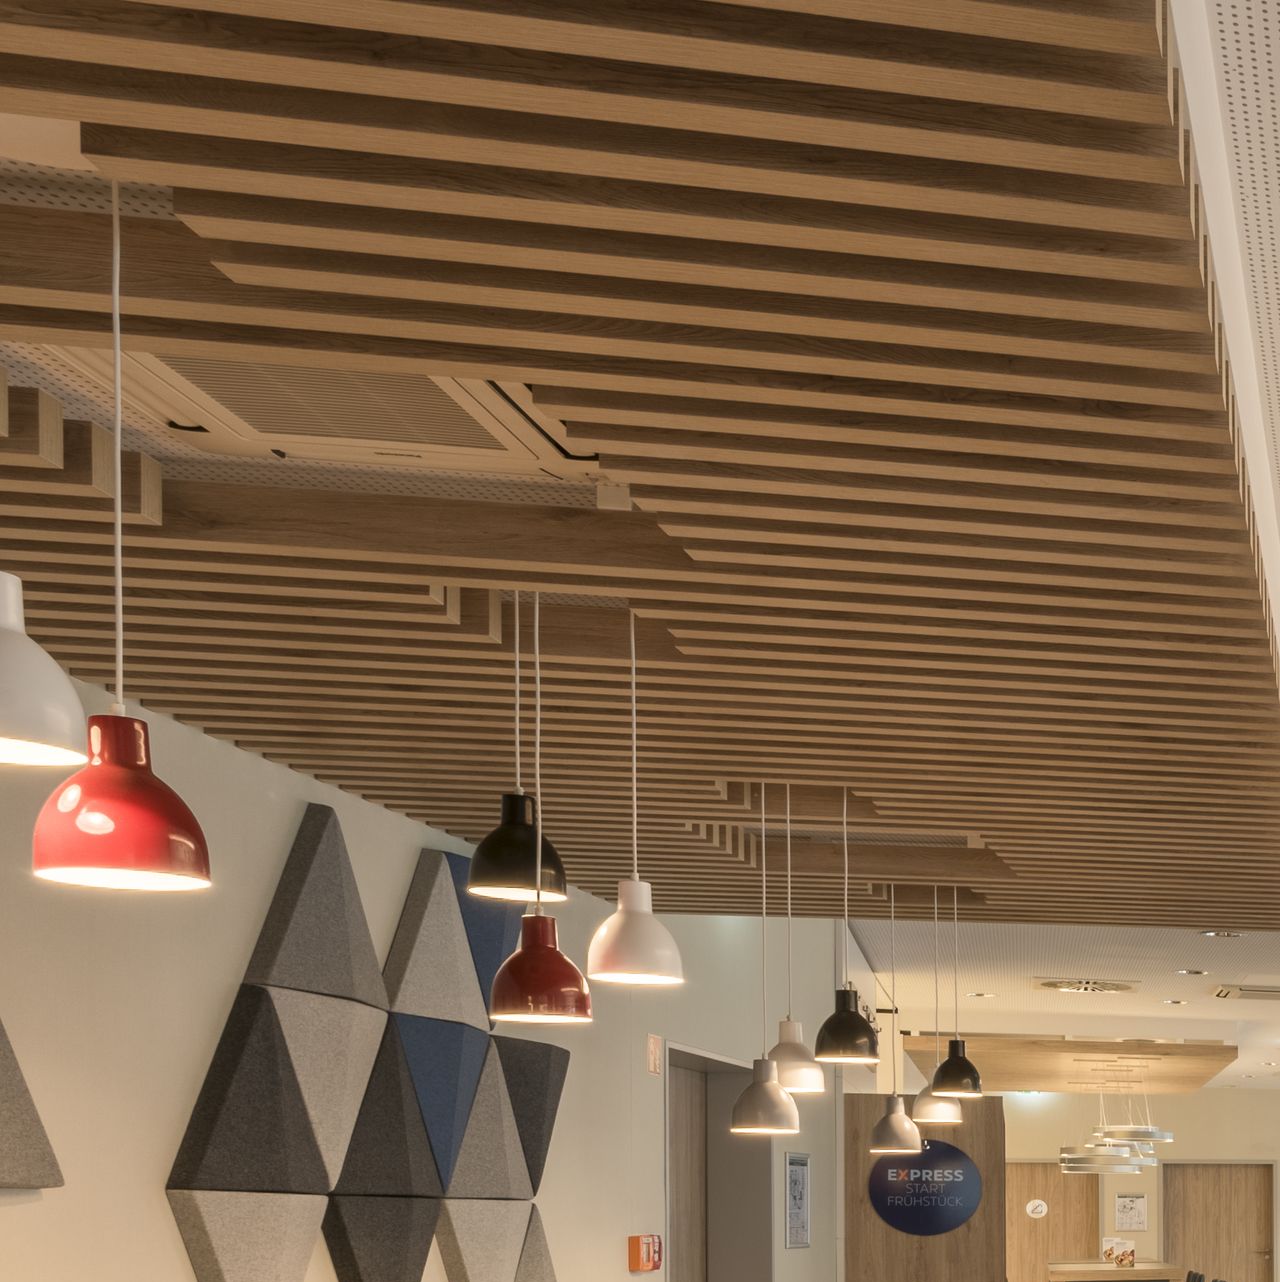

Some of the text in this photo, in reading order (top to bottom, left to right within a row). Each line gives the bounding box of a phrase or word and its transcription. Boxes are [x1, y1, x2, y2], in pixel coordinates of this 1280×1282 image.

[887, 1168, 964, 1182] EXPRESS
[905, 1183, 946, 1194] START
[887, 1194, 964, 1207] FRÜHSTÜCK
